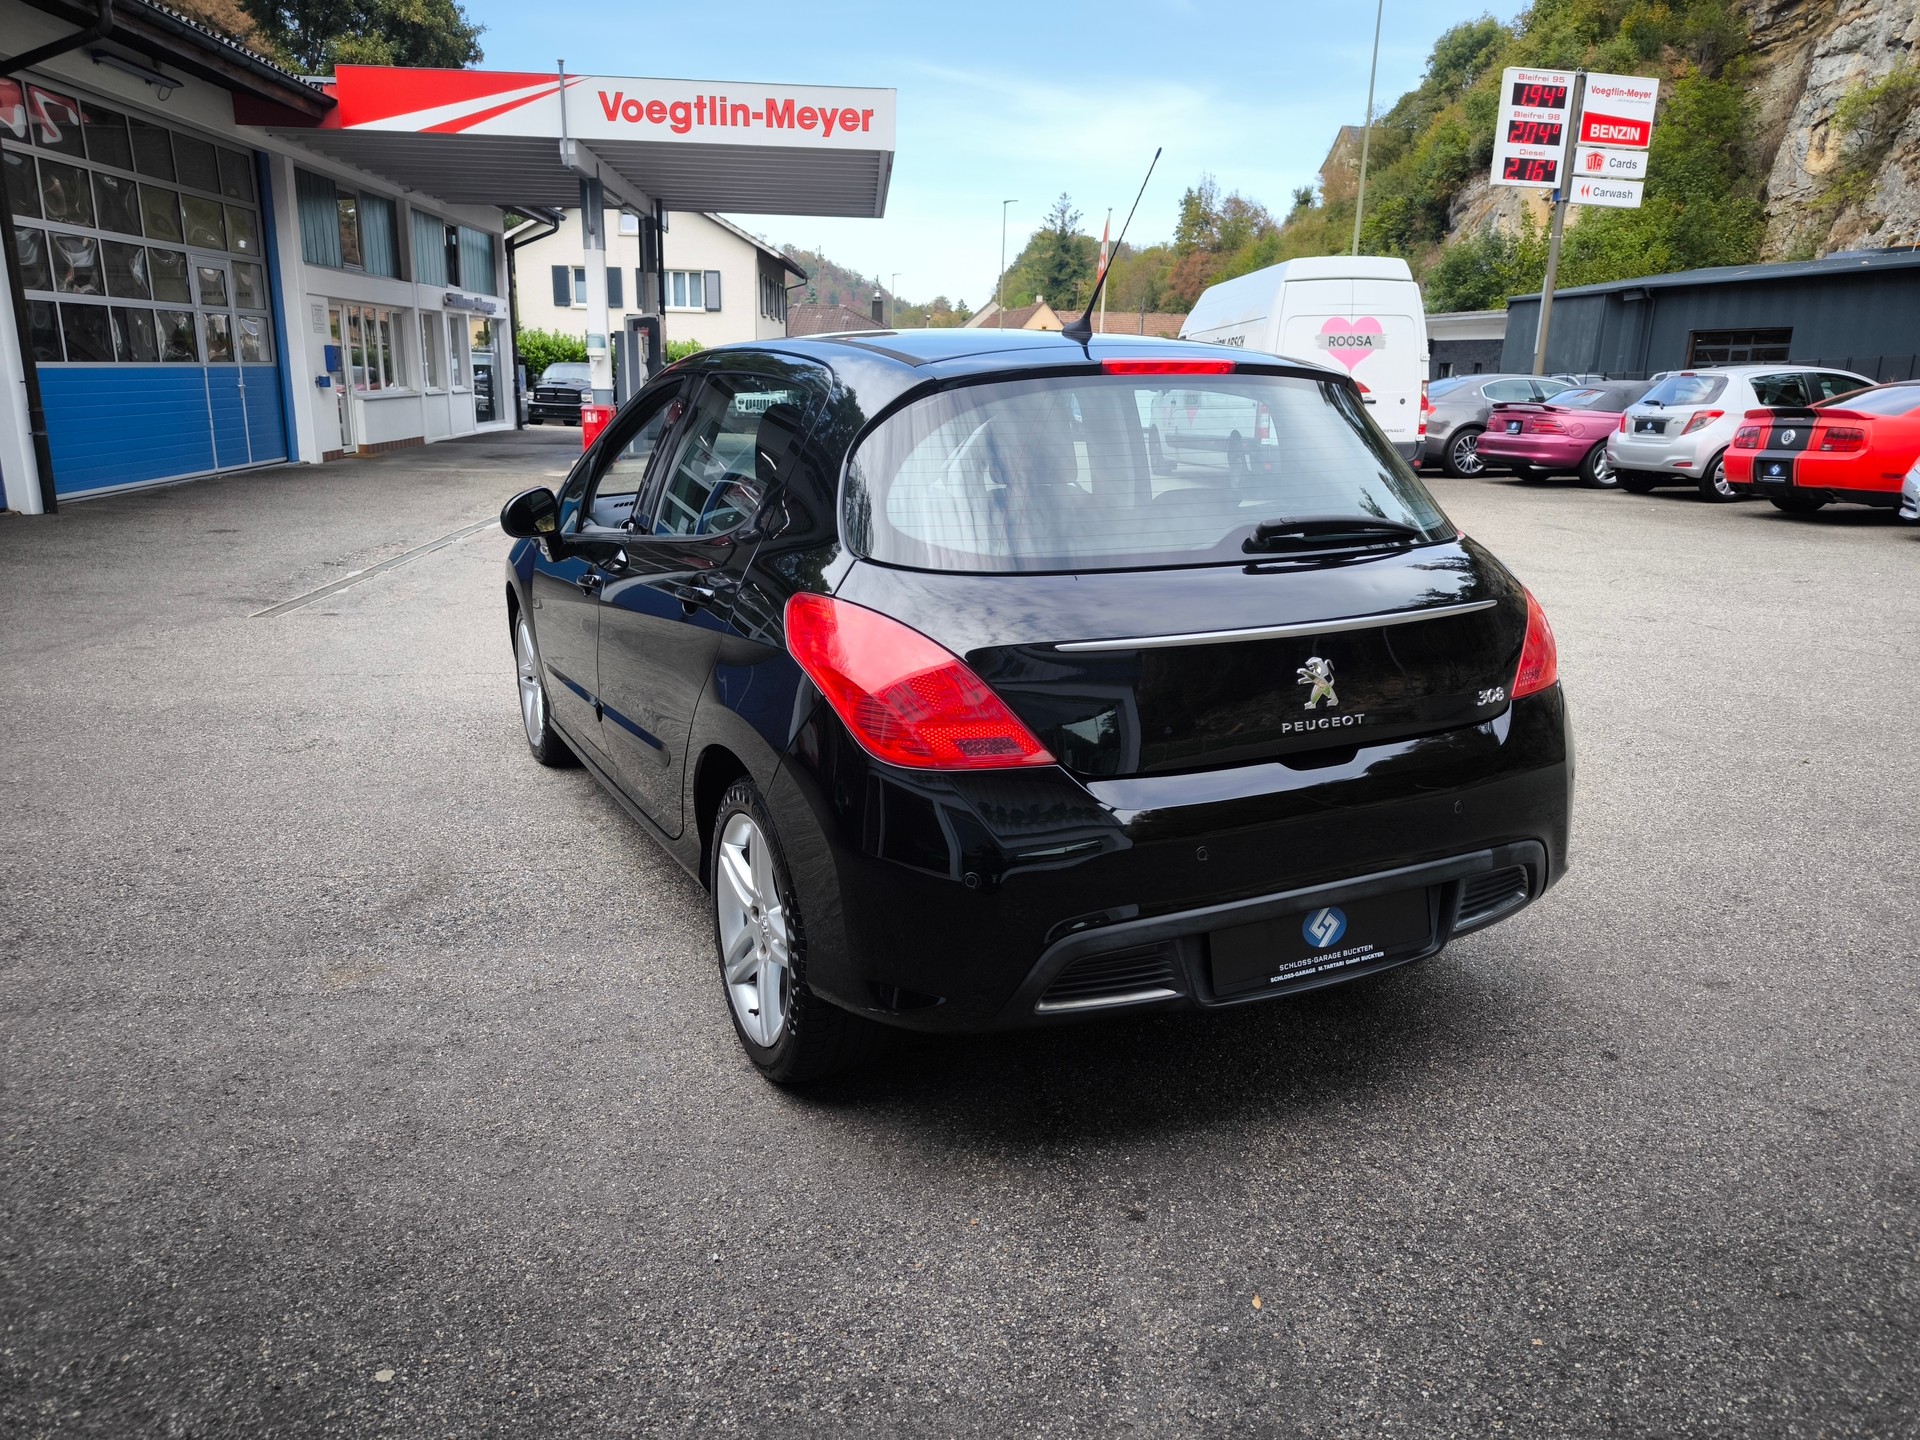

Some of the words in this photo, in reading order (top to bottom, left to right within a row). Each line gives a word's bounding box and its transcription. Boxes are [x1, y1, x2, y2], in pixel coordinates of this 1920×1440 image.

[1518, 73, 1549, 82] Bleifrei
[1552, 75, 1565, 83] 95
[1591, 85, 1652, 100] Voegtlin-Meyer
[598, 91, 874, 137] Voegtlin-Meyer
[1513, 111, 1544, 120] Bleifrei
[1547, 113, 1560, 121] 98
[1590, 123, 1640, 141] BENZIN
[1519, 148, 1545, 157] Diesel
[1609, 157, 1637, 169] Cards
[1593, 186, 1633, 199] Carwash
[1328, 335, 1373, 347] ROOSA
[1476, 686, 1505, 706] 308
[1281, 713, 1365, 734] PEUGEOT
[1342, 944, 1374, 957] BUCKTEN
[1361, 951, 1385, 962] BUCKTEN
